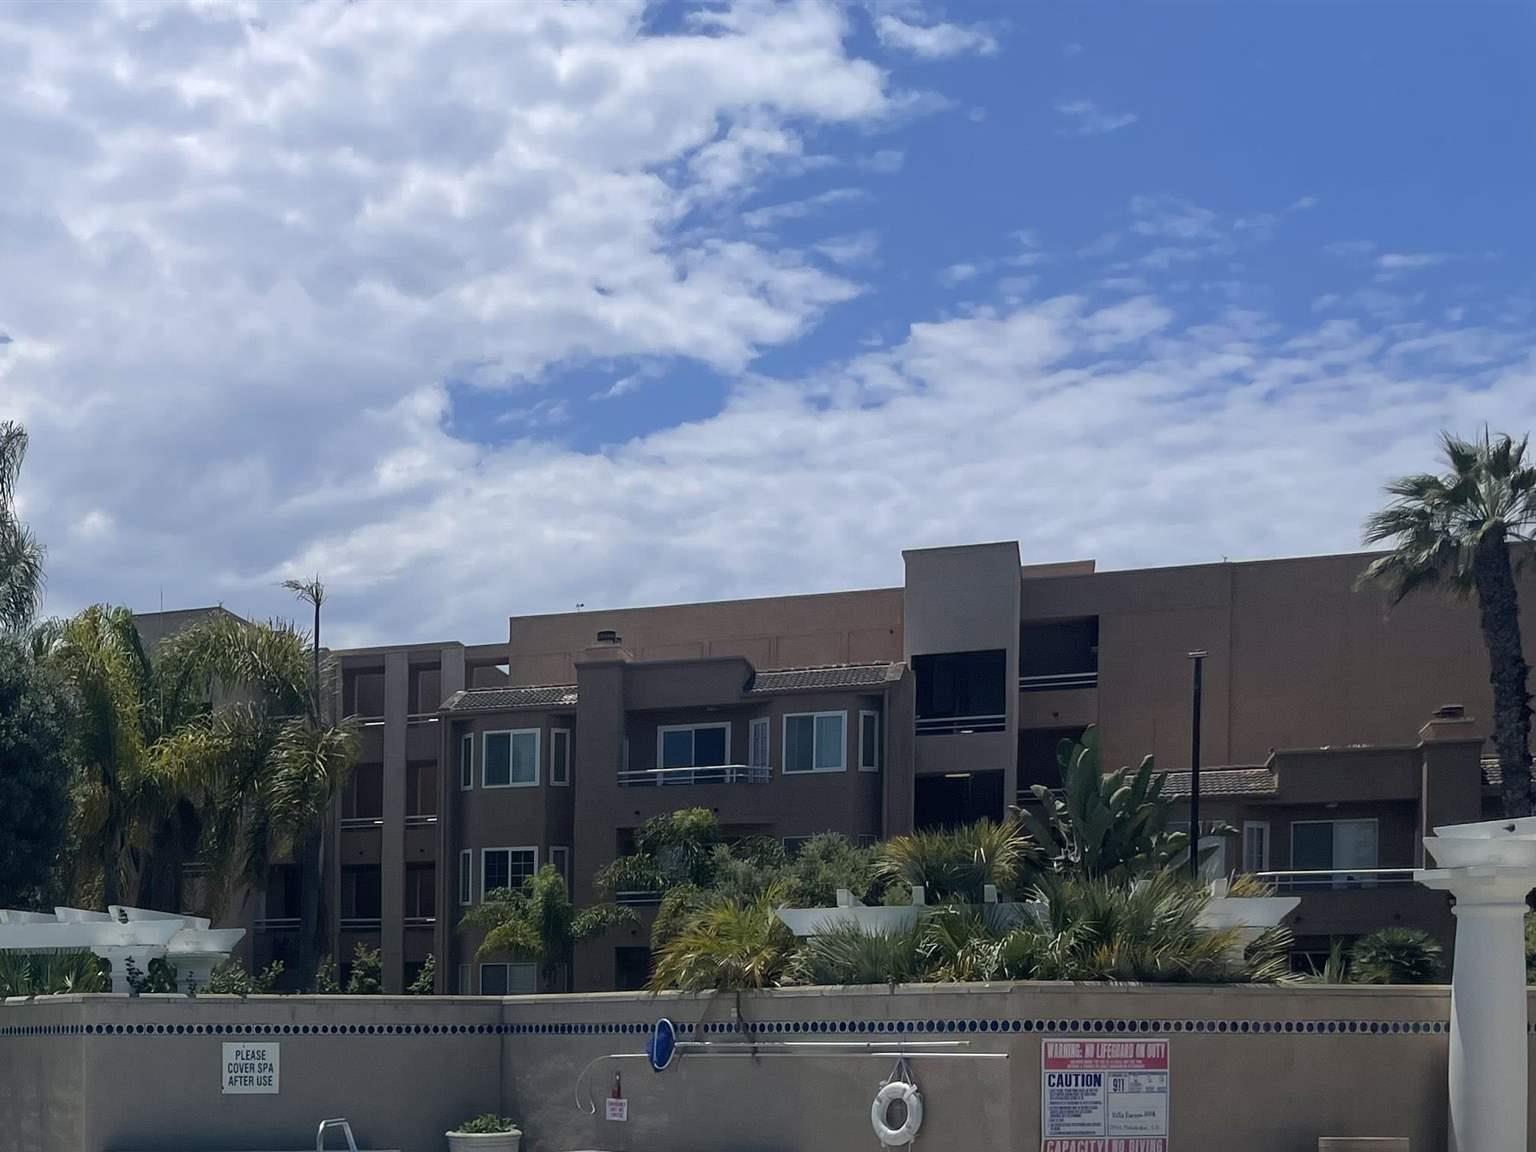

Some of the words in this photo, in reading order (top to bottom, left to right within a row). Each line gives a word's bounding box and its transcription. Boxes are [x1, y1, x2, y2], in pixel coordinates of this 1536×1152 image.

[235, 1050, 267, 1061] PLEASE
[227, 1062, 255, 1074] COVER
[257, 1062, 274, 1074] SPA
[228, 1075, 254, 1087] AFTER
[256, 1075, 273, 1087] USE
[1048, 1073, 1102, 1088] CAUTION
[1112, 1078, 1125, 1092] 911
